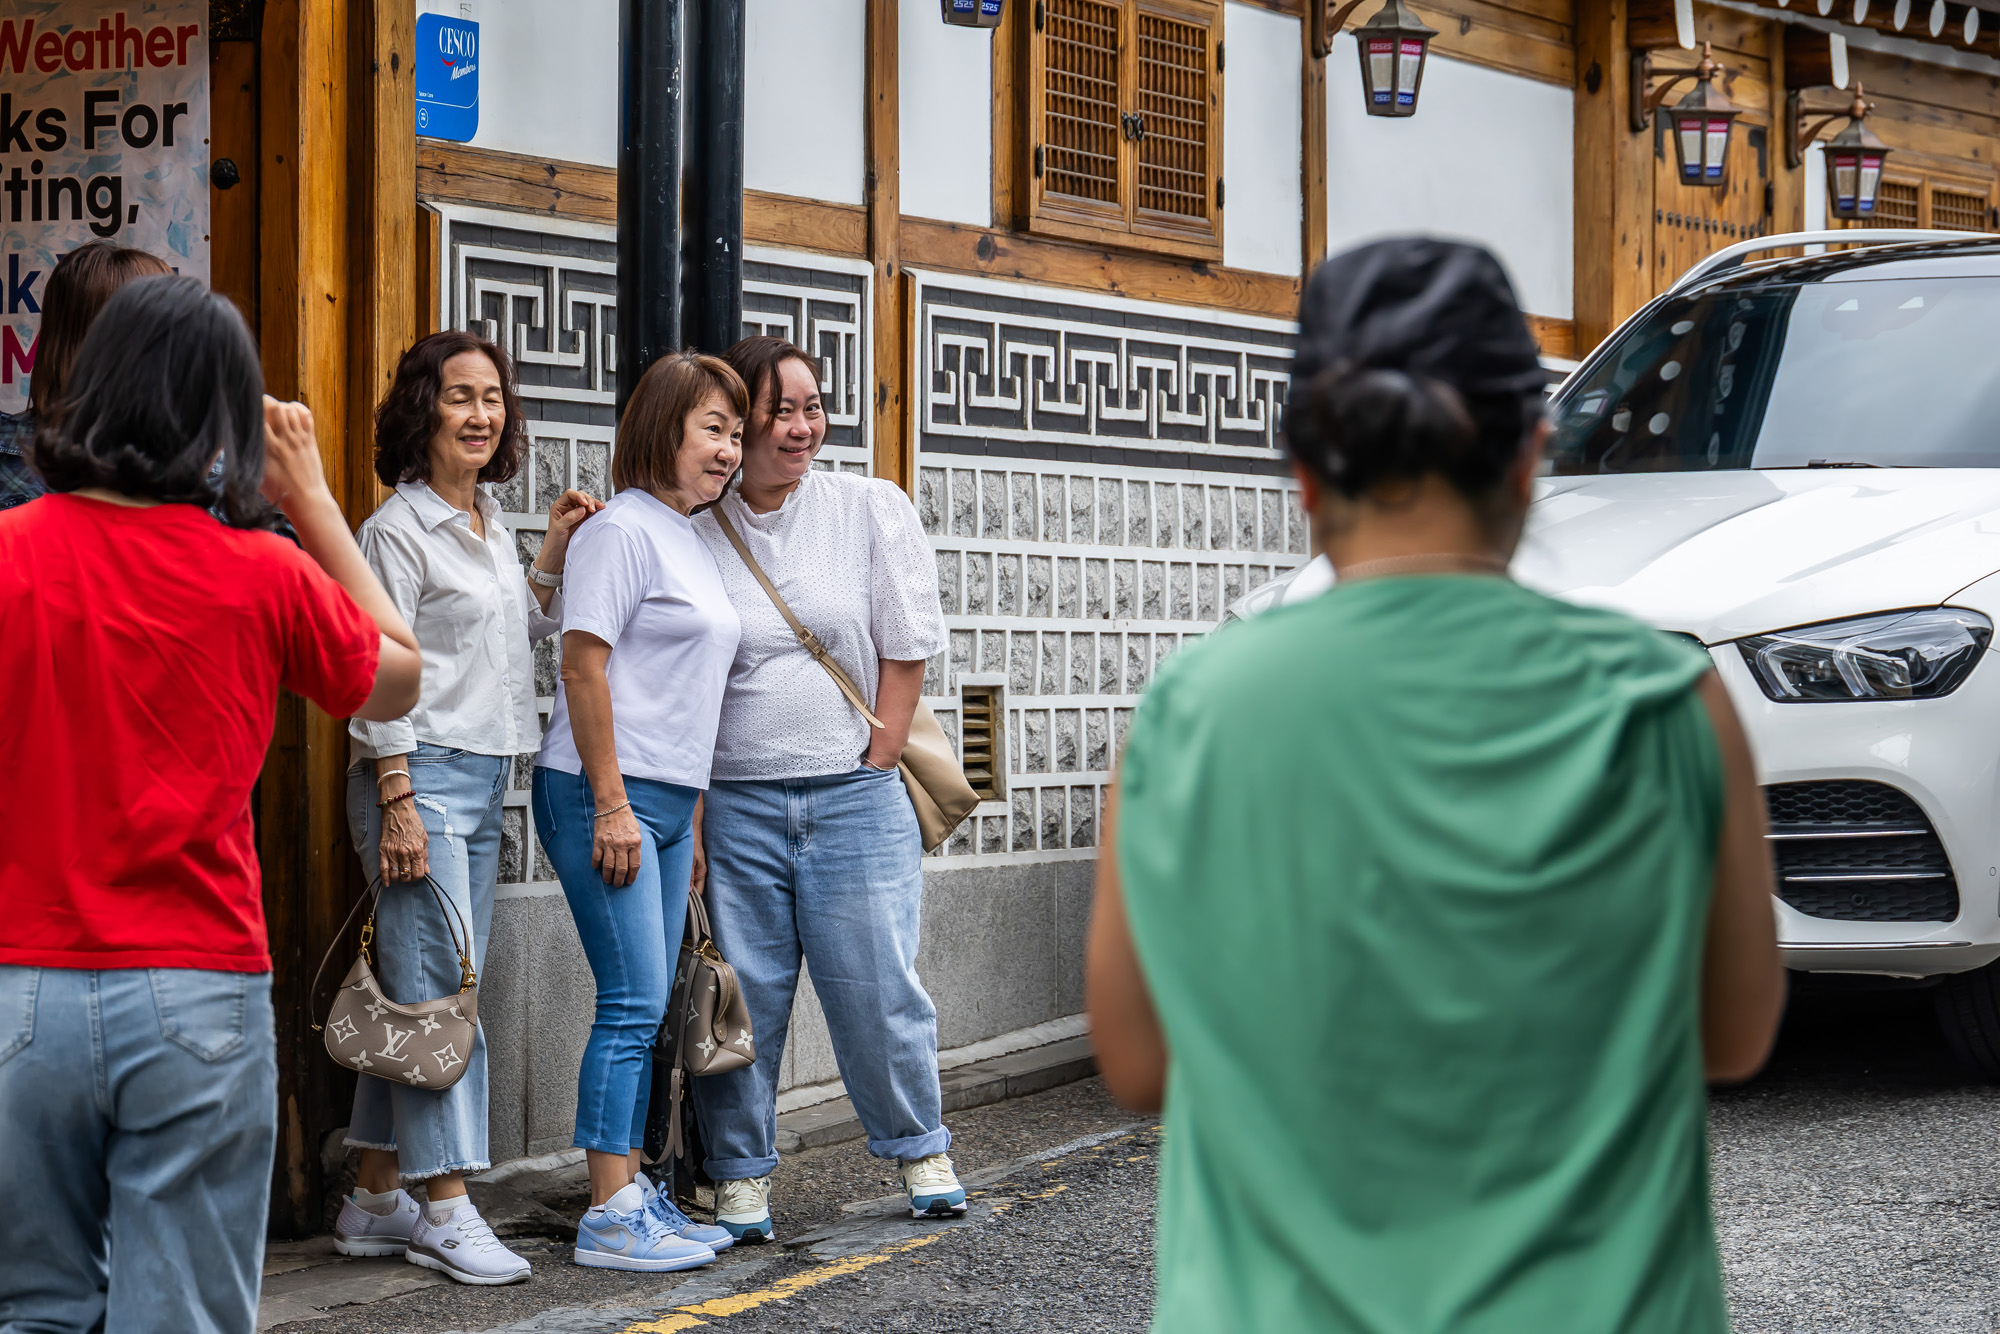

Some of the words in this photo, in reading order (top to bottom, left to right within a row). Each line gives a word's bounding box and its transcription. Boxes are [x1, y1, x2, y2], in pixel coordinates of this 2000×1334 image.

[439, 26, 475, 58] CESCO
[450, 60, 476, 81] Members
[84, 89, 188, 150] For
[0, 253, 43, 315] k
